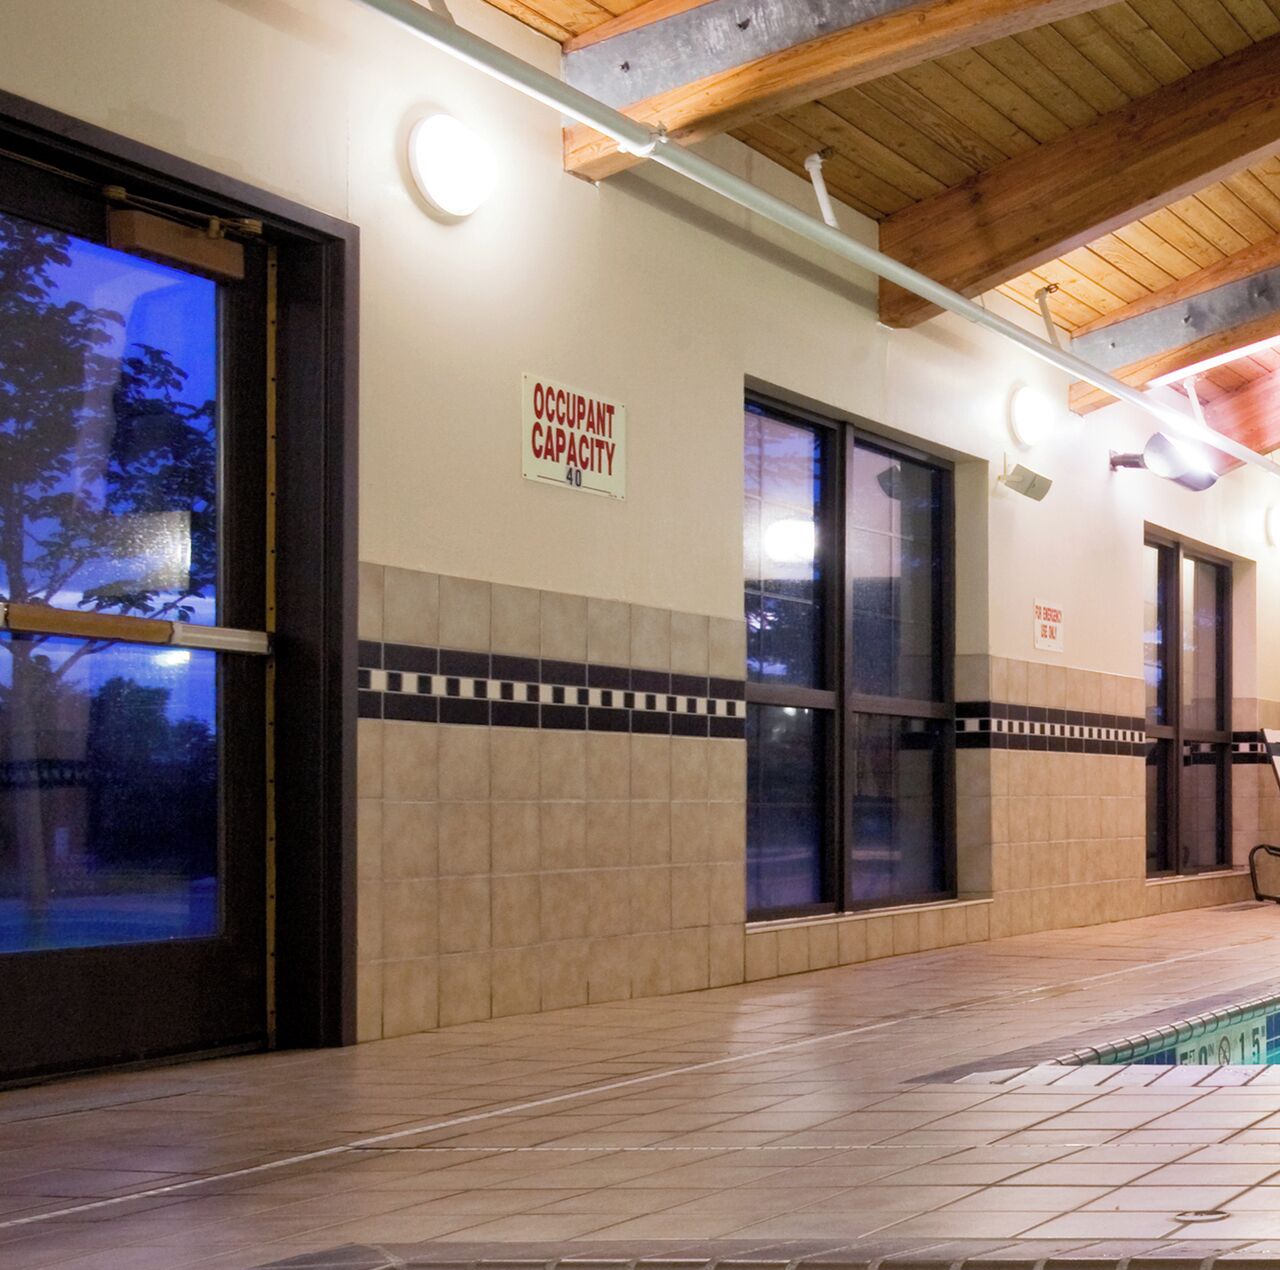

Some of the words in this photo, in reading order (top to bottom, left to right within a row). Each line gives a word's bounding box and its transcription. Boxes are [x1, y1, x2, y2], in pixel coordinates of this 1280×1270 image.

[533, 382, 615, 439] OCCUPANT
[531, 421, 616, 476] CAPACITY
[566, 467, 582, 487] 40
